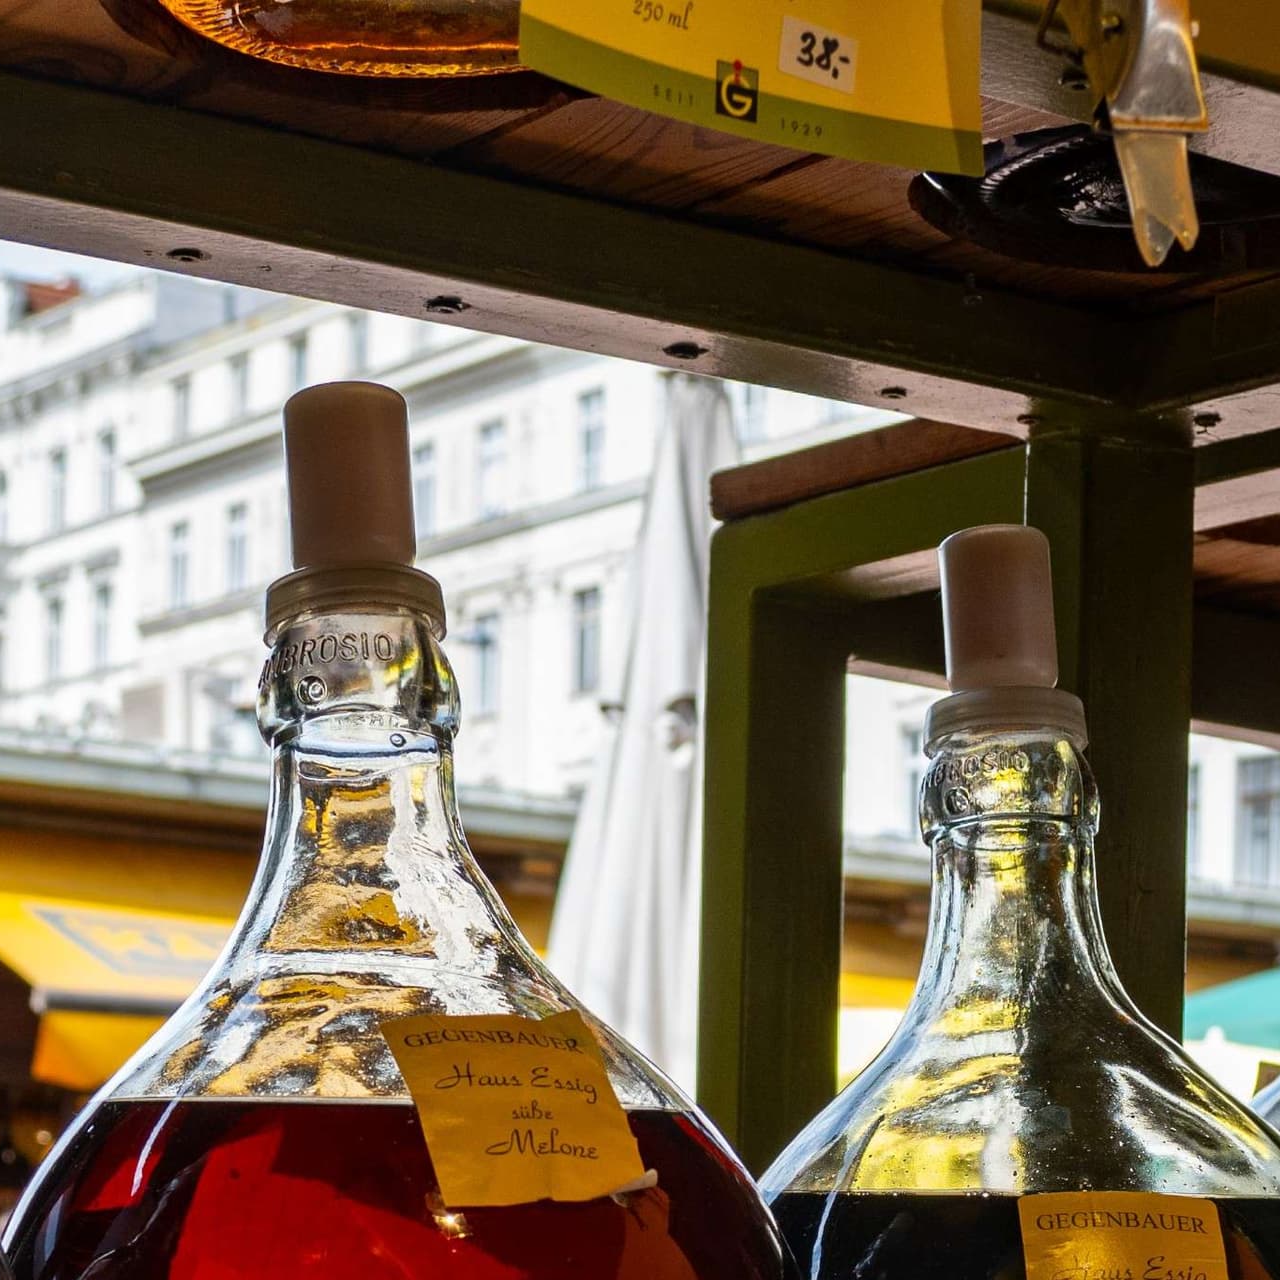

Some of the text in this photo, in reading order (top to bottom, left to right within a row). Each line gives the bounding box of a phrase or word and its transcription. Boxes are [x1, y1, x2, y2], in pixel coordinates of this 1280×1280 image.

[632, 0, 692, 31] 250 ml
[779, 117, 824, 137] 1929
[403, 1028, 584, 1055] GEGENBAUER
[434, 1061, 597, 1105] Haus Essig
[511, 1099, 554, 1121] süße
[485, 1128, 599, 1160] Melone
[1036, 1210, 1209, 1235] GEGENBAUER
